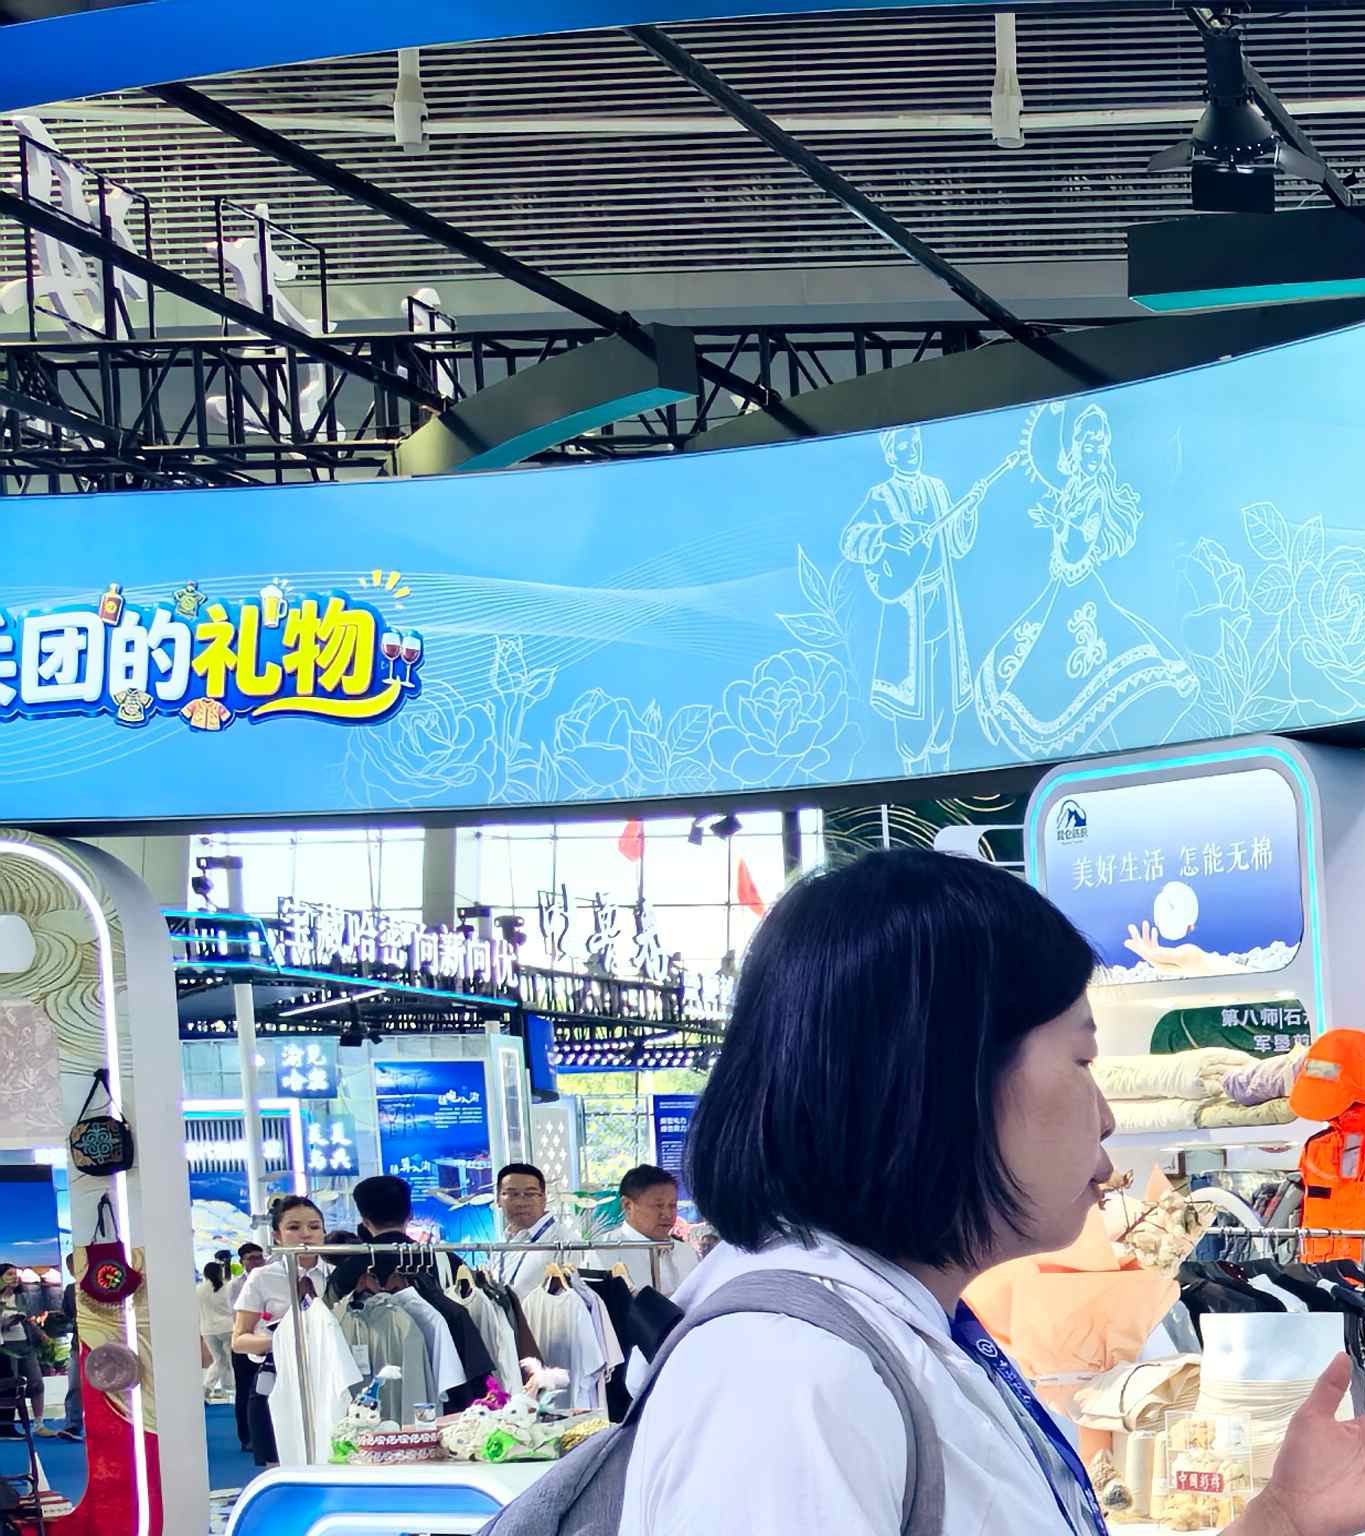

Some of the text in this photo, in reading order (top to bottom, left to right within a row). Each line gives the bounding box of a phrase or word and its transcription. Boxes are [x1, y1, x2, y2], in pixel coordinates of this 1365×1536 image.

[0, 597, 378, 705] 团的礼物
[1072, 836, 1273, 890] 美好生活 怎能无棉
